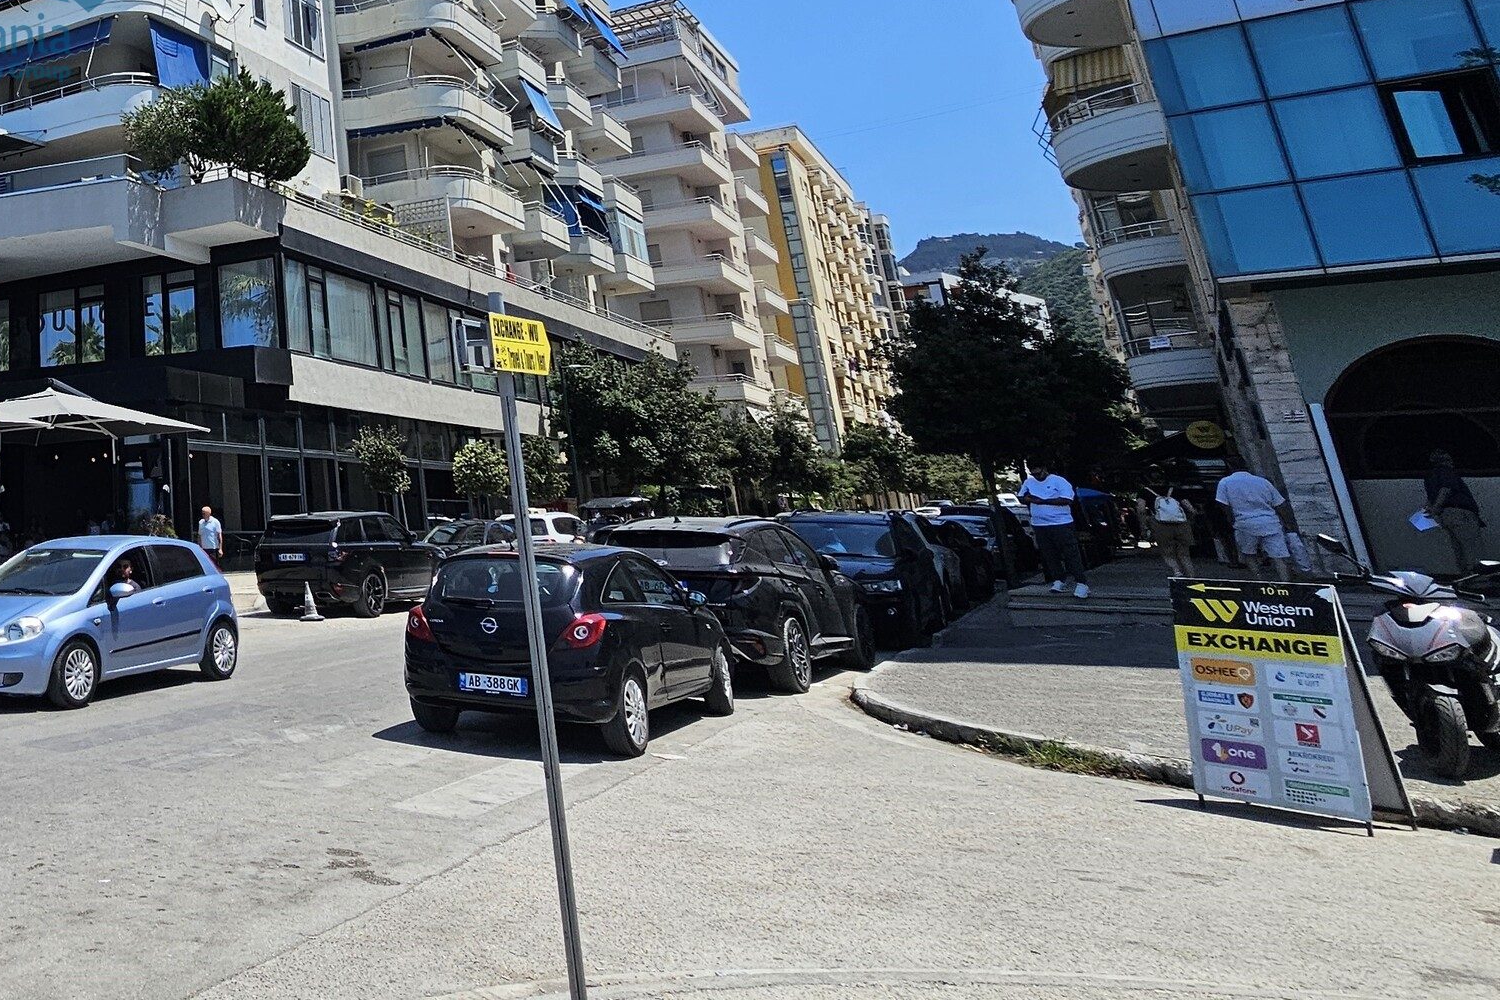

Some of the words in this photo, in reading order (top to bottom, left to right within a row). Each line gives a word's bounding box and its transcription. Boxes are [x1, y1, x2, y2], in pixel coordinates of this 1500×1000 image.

[493, 317, 524, 340] EXCHANGE
[1260, 587, 1274, 596] 10
[1242, 601, 1314, 617] Western
[1245, 613, 1296, 628] Union
[1187, 632, 1329, 657] EXCHANGE
[1195, 664, 1238, 678] OSHEE
[469, 675, 481, 687] AB
[1228, 748, 1256, 759] one
[1221, 785, 1257, 795] vodafone
